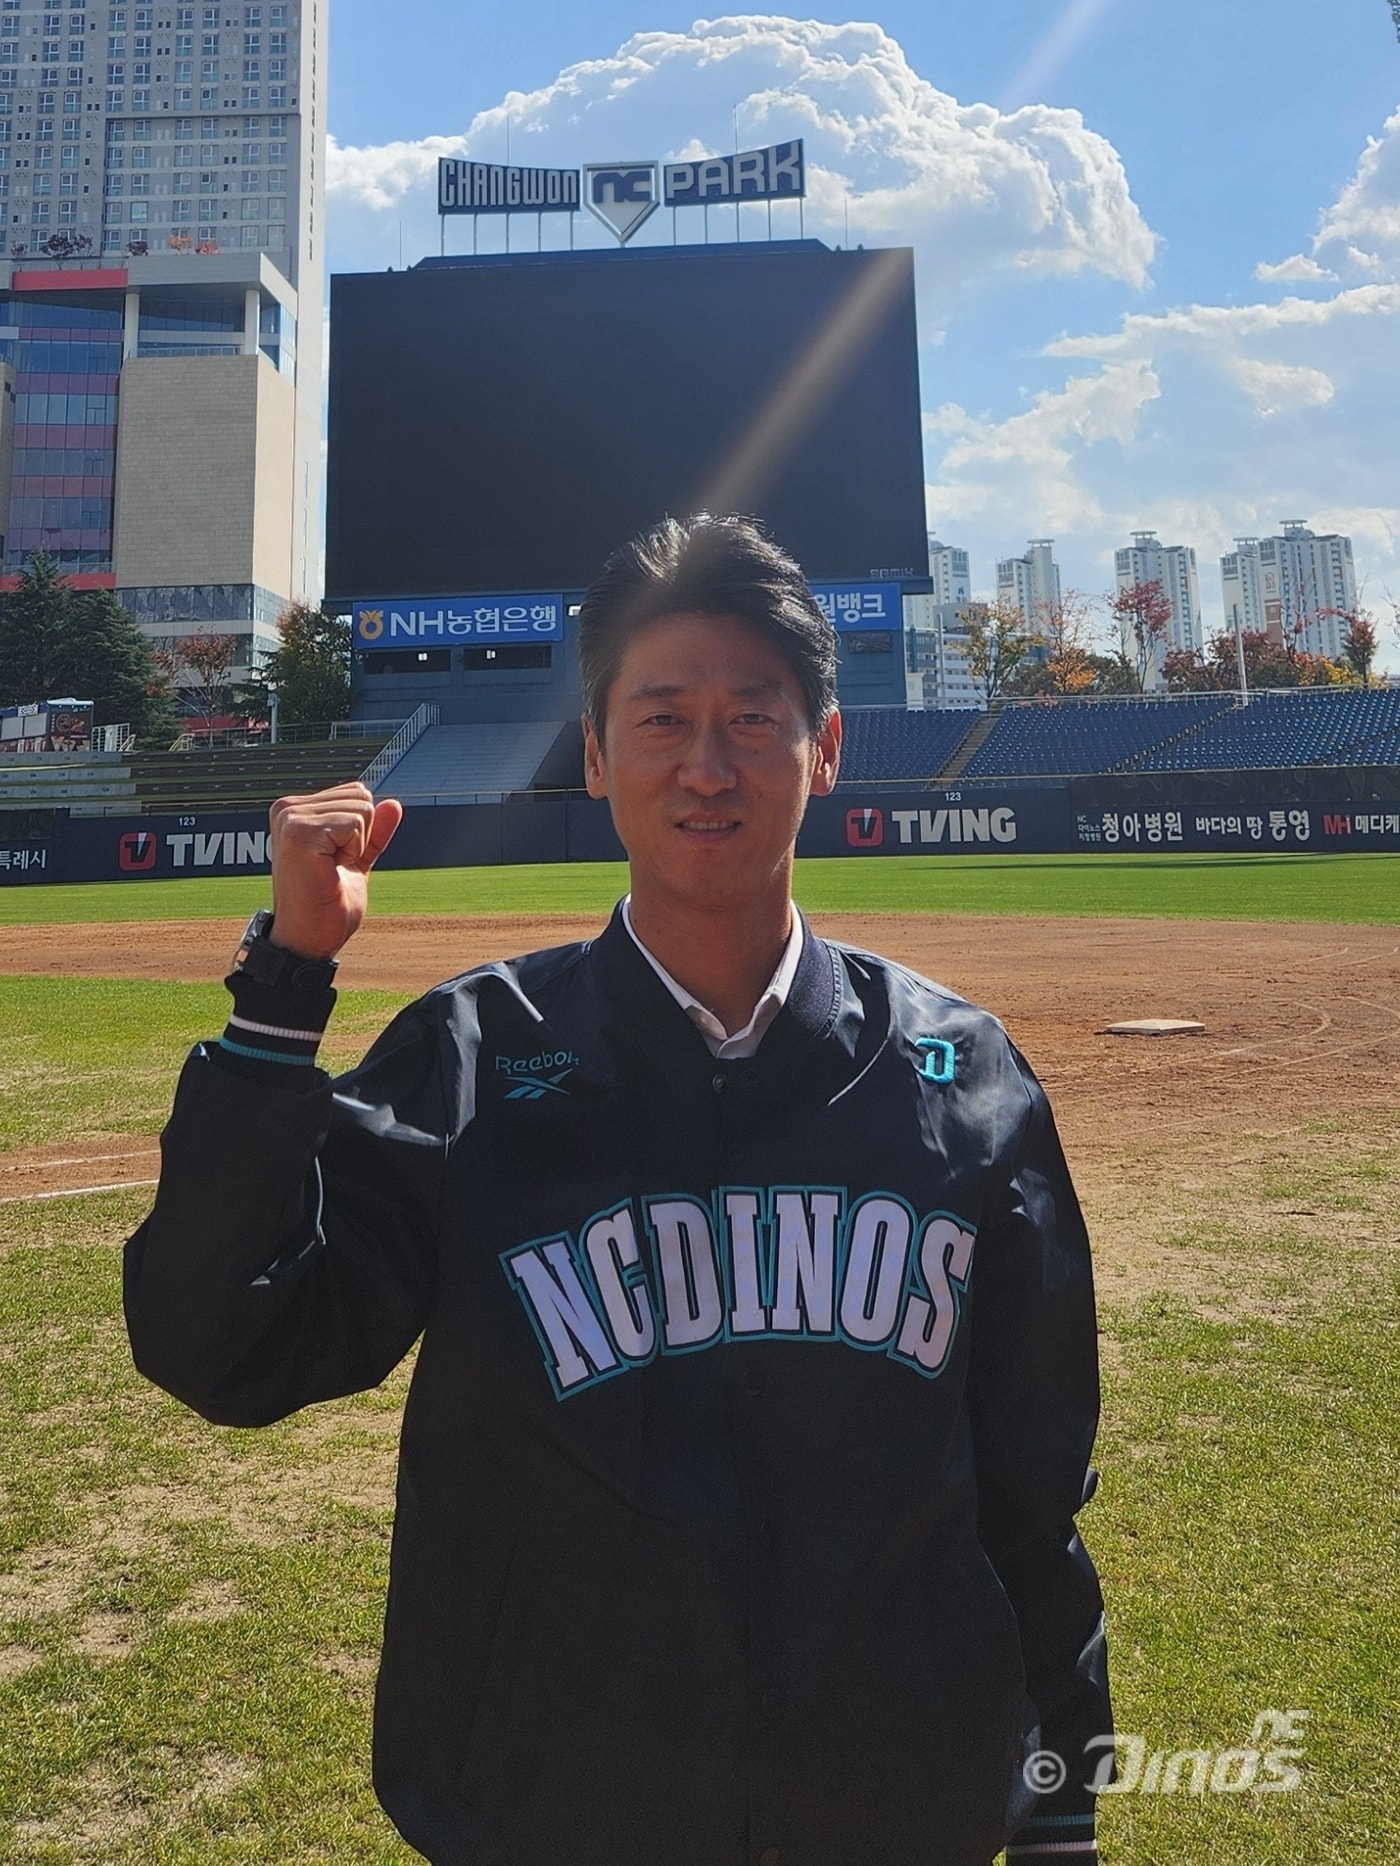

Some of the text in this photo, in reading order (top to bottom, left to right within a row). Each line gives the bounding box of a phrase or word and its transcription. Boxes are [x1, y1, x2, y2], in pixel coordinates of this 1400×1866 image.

[440, 158, 579, 207] CHANGWON
[666, 142, 801, 199] PARK
[390, 605, 556, 637] NH농협은행
[945, 792, 962, 801] 123
[179, 817, 196, 826] 123
[891, 807, 1017, 844] TVING
[1101, 812, 1183, 842] 청아병원
[1195, 810, 1310, 841] 바다의 땅 통영
[166, 831, 273, 867] TVIN
[495, 1051, 580, 1075] Reebok
